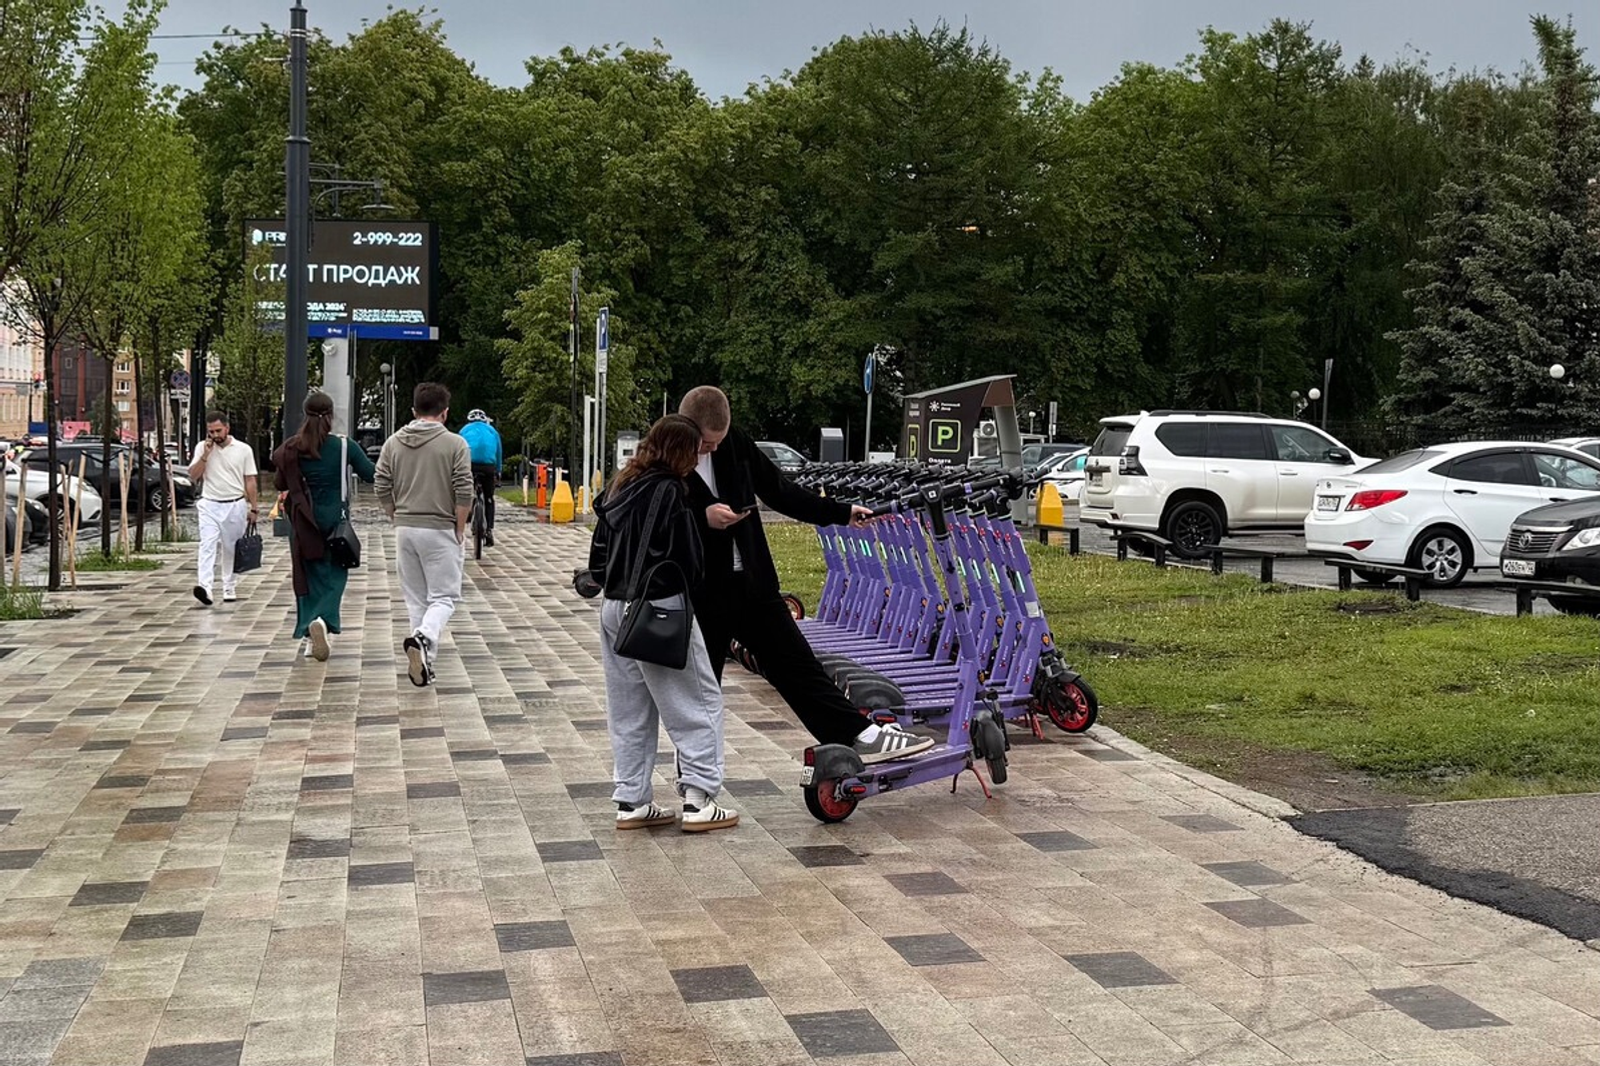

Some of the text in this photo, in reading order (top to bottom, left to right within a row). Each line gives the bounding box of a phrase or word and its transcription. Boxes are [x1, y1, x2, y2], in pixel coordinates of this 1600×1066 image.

[353, 231, 423, 247] 2-999-222
[253, 263, 421, 287] СТАТ ПРОДАЖ
[937, 426, 953, 445] P
